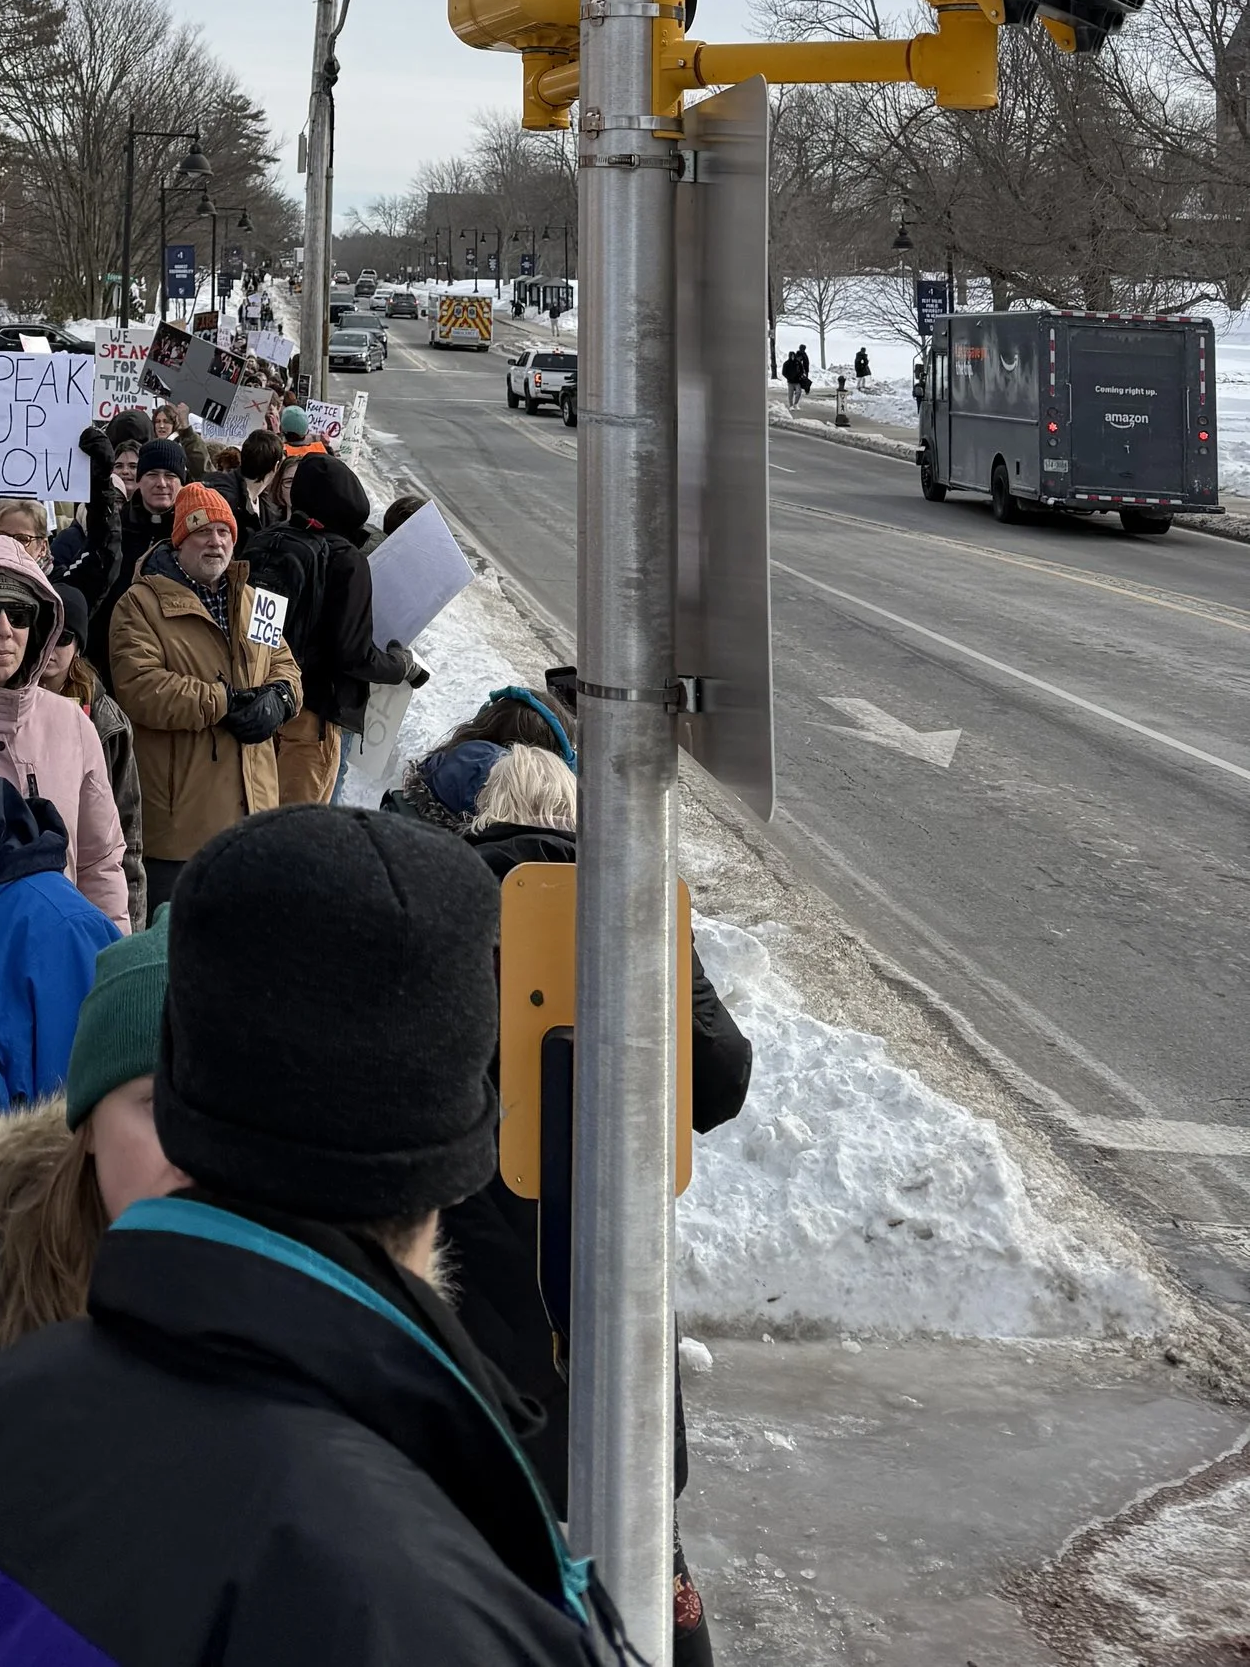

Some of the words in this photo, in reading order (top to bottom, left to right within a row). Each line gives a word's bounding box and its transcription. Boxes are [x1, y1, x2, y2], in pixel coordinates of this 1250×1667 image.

[109, 329, 132, 344] WE
[99, 343, 149, 360] SPEAK
[113, 360, 138, 375] FOR
[1094, 385, 1124, 395] Coming
[1124, 386, 1145, 396] right
[1145, 389, 1158, 397] up.
[111, 394, 138, 404] WHO
[324, 405, 338, 418] ICE
[1104, 412, 1149, 424] amazon
[254, 594, 276, 621] NO
[250, 617, 282, 646] ICE
